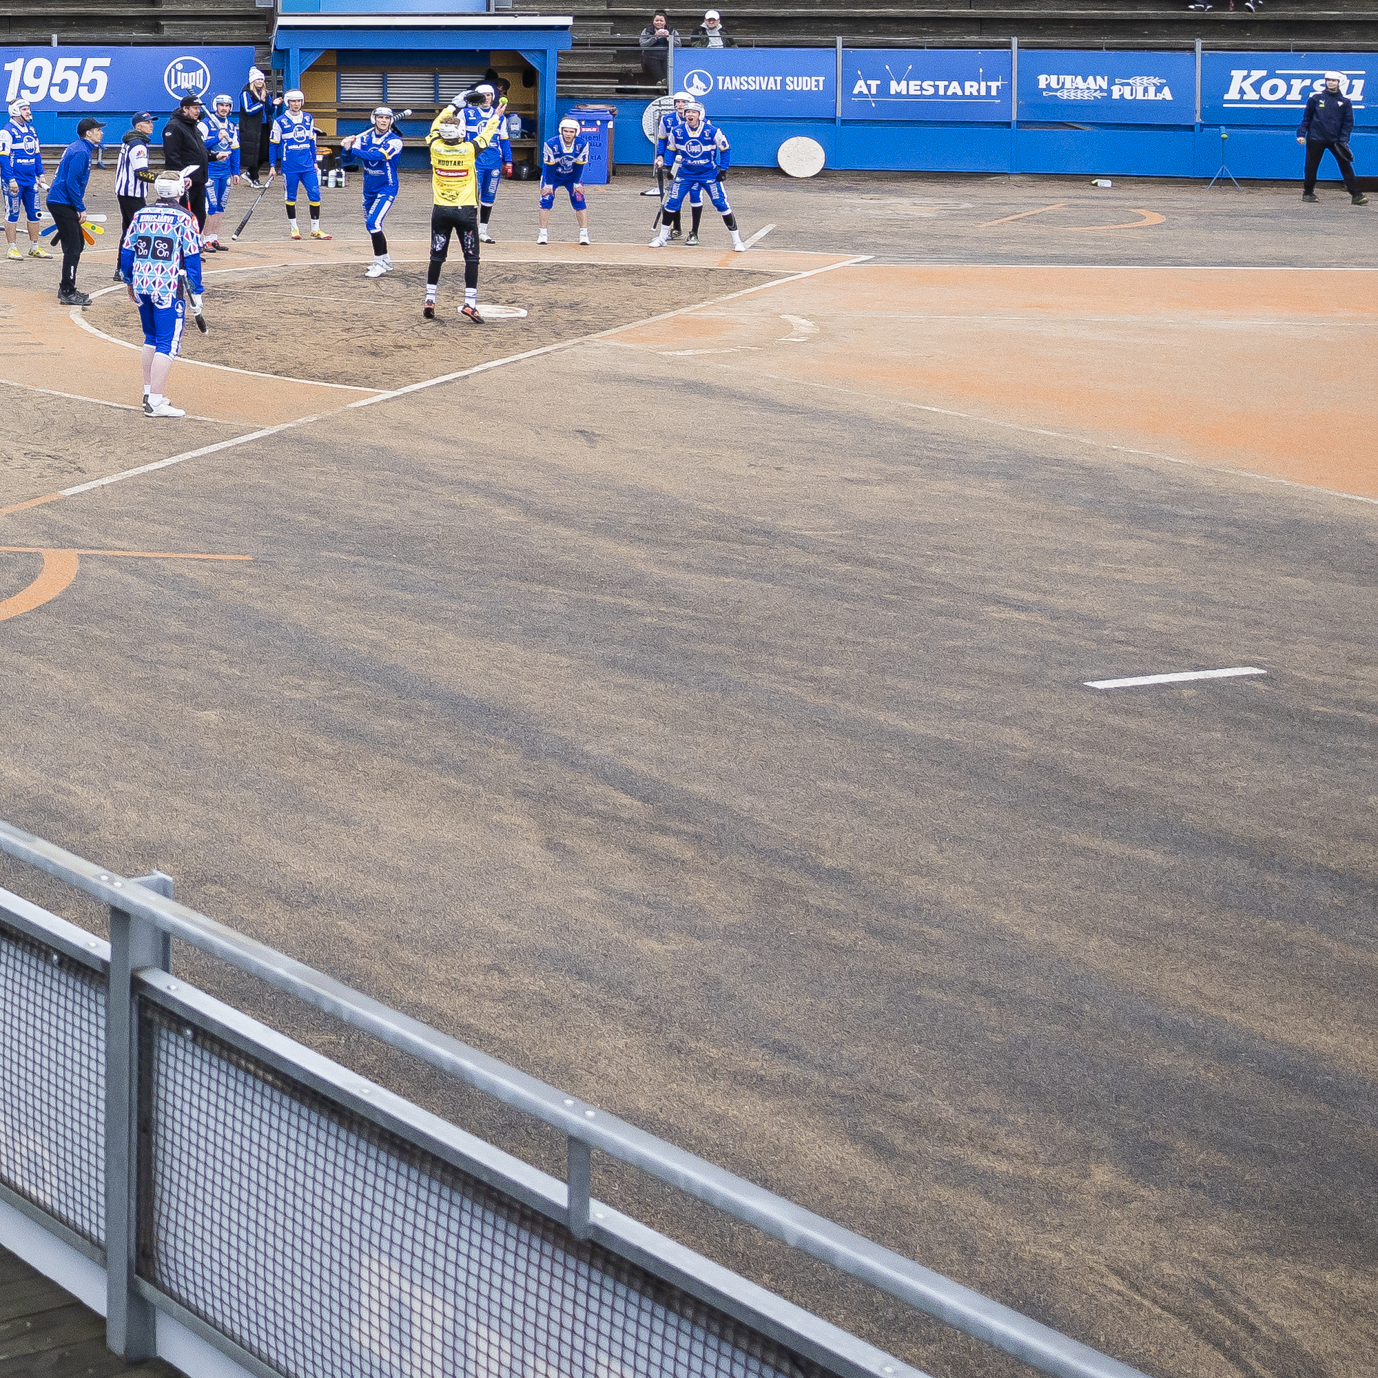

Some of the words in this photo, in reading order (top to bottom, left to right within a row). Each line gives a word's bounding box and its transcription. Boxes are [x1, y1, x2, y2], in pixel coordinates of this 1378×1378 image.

[3, 57, 111, 103] 1955
[716, 75, 782, 91] TANSSIVAT
[785, 76, 825, 91] SUDET
[852, 79, 881, 95] AT
[889, 80, 1001, 96] MESTARIT
[1037, 74, 1108, 90] PUTAAN
[1110, 84, 1173, 101] PULLA
[154, 240, 168, 249] Go
[157, 248, 169, 257] On
